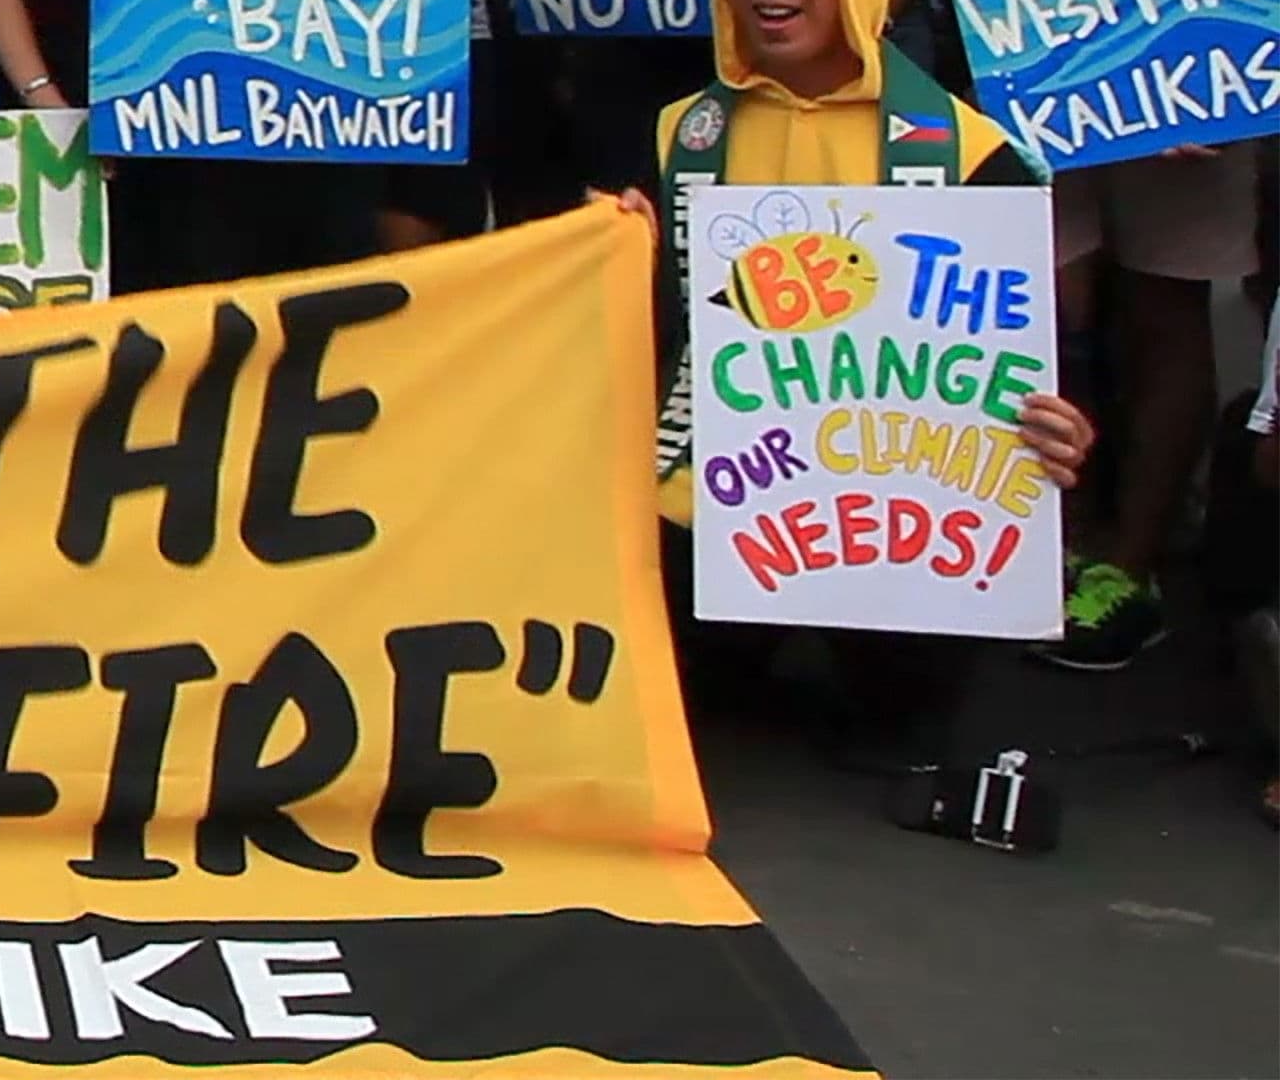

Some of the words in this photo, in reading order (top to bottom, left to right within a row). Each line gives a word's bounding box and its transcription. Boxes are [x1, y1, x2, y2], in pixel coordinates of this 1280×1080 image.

[114, 73, 241, 153] MNL
[246, 77, 455, 151] BAYWATCH
[745, 235, 852, 329] BE
[894, 233, 1032, 334] THE
[710, 331, 1043, 422] CHANGE
[703, 428, 808, 507] OUR
[815, 409, 1046, 519] CLIMATE
[732, 493, 1022, 593] NEEDS!
